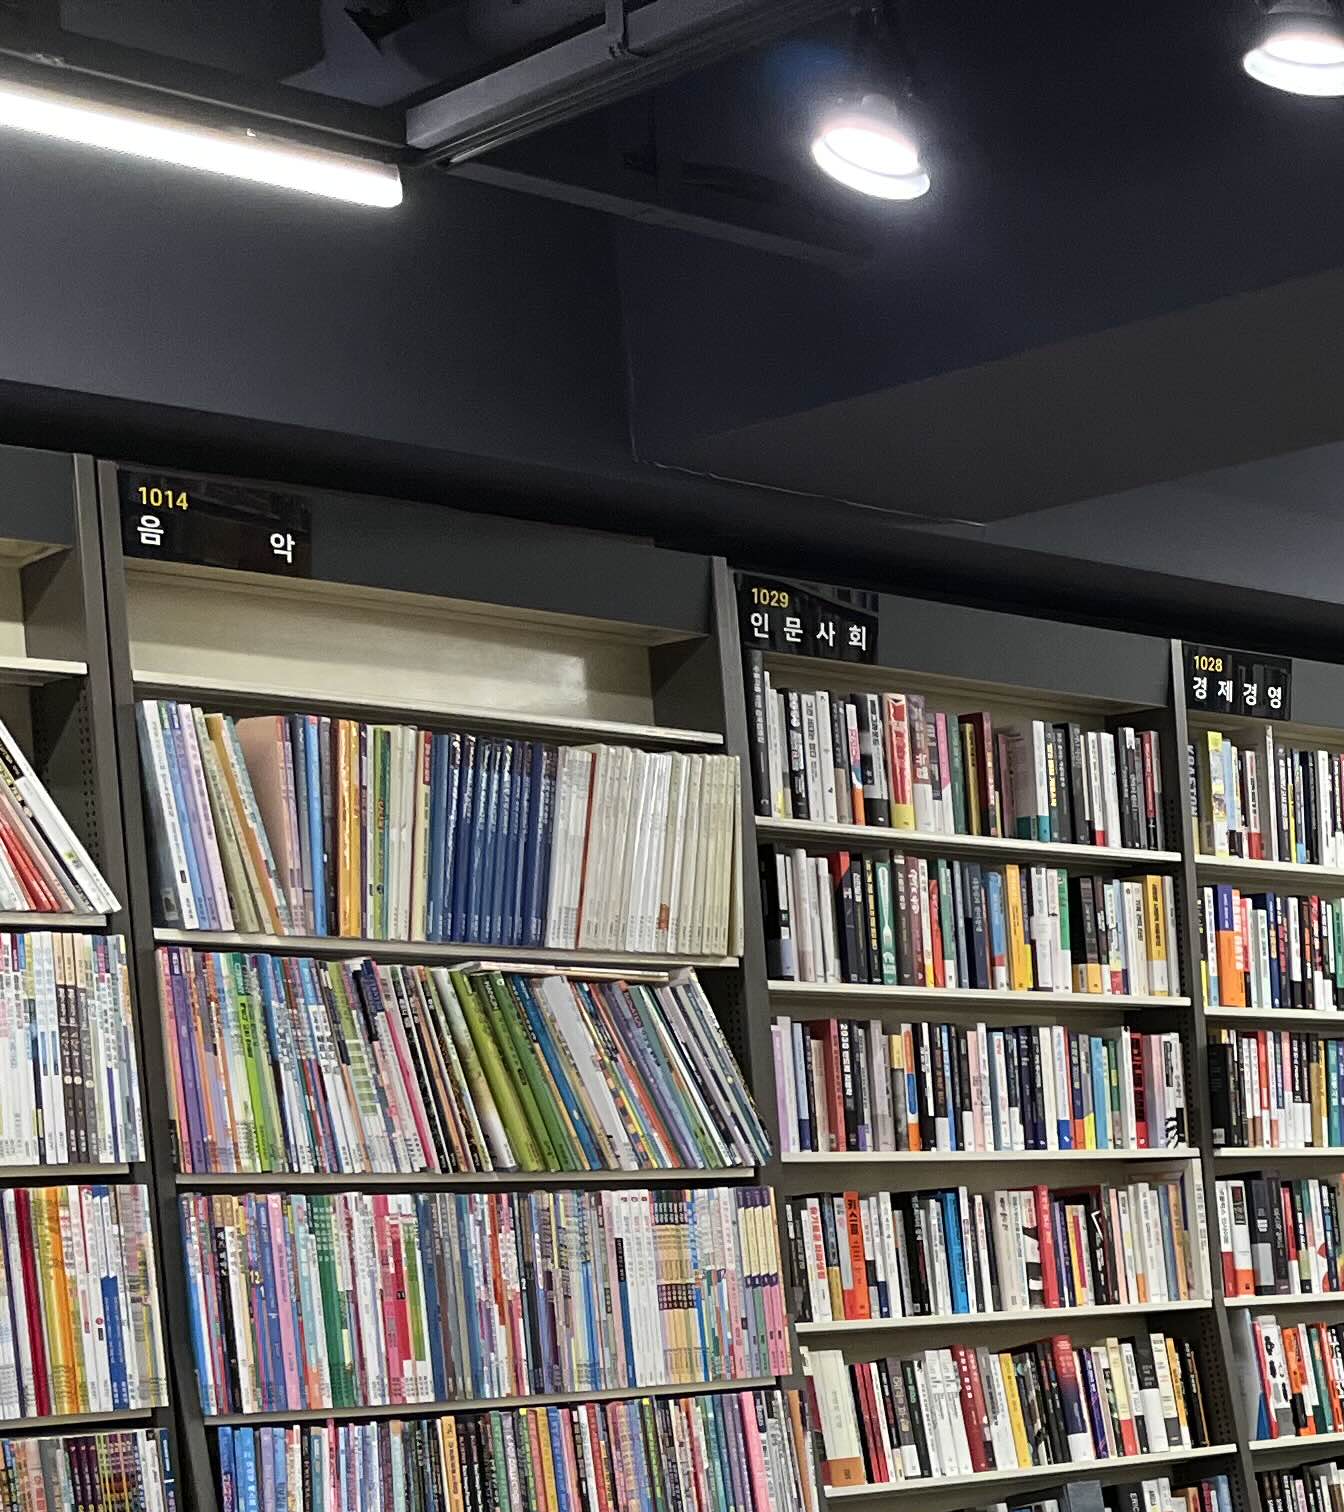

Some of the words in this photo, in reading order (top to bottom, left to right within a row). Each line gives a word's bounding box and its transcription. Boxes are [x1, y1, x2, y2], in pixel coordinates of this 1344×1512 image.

[138, 486, 188, 510] 1014
[751, 588, 790, 608] 1029
[750, 612, 869, 651] 인문사회
[1193, 656, 1223, 673] 1028
[1192, 676, 1282, 710] 경제경영
[840, 1023, 850, 1050] 2030
[1129, 1492, 1138, 1512] ERIC
